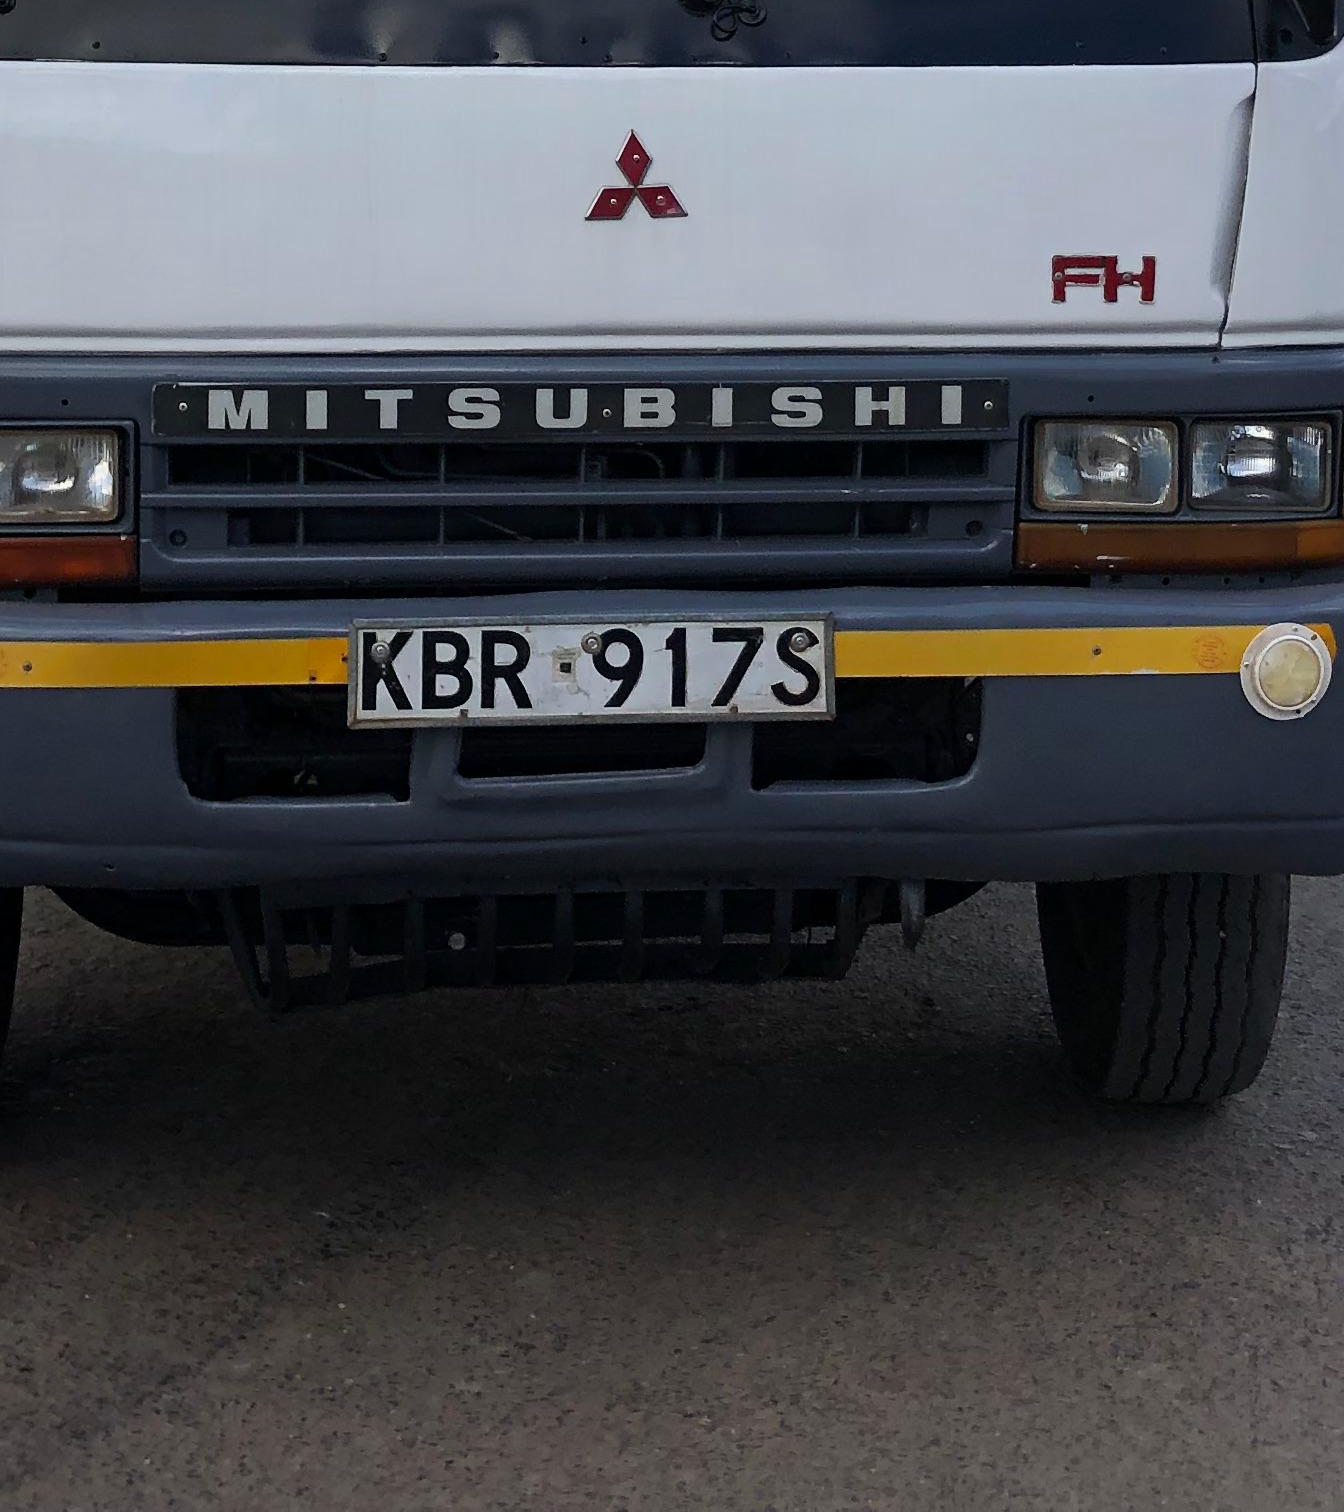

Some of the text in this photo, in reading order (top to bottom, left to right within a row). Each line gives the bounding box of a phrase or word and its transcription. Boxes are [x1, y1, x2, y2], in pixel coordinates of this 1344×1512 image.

[1051, 255, 1156, 304] FH
[207, 384, 963, 431] MITSUBISHI
[361, 627, 821, 711] KBR 917S
